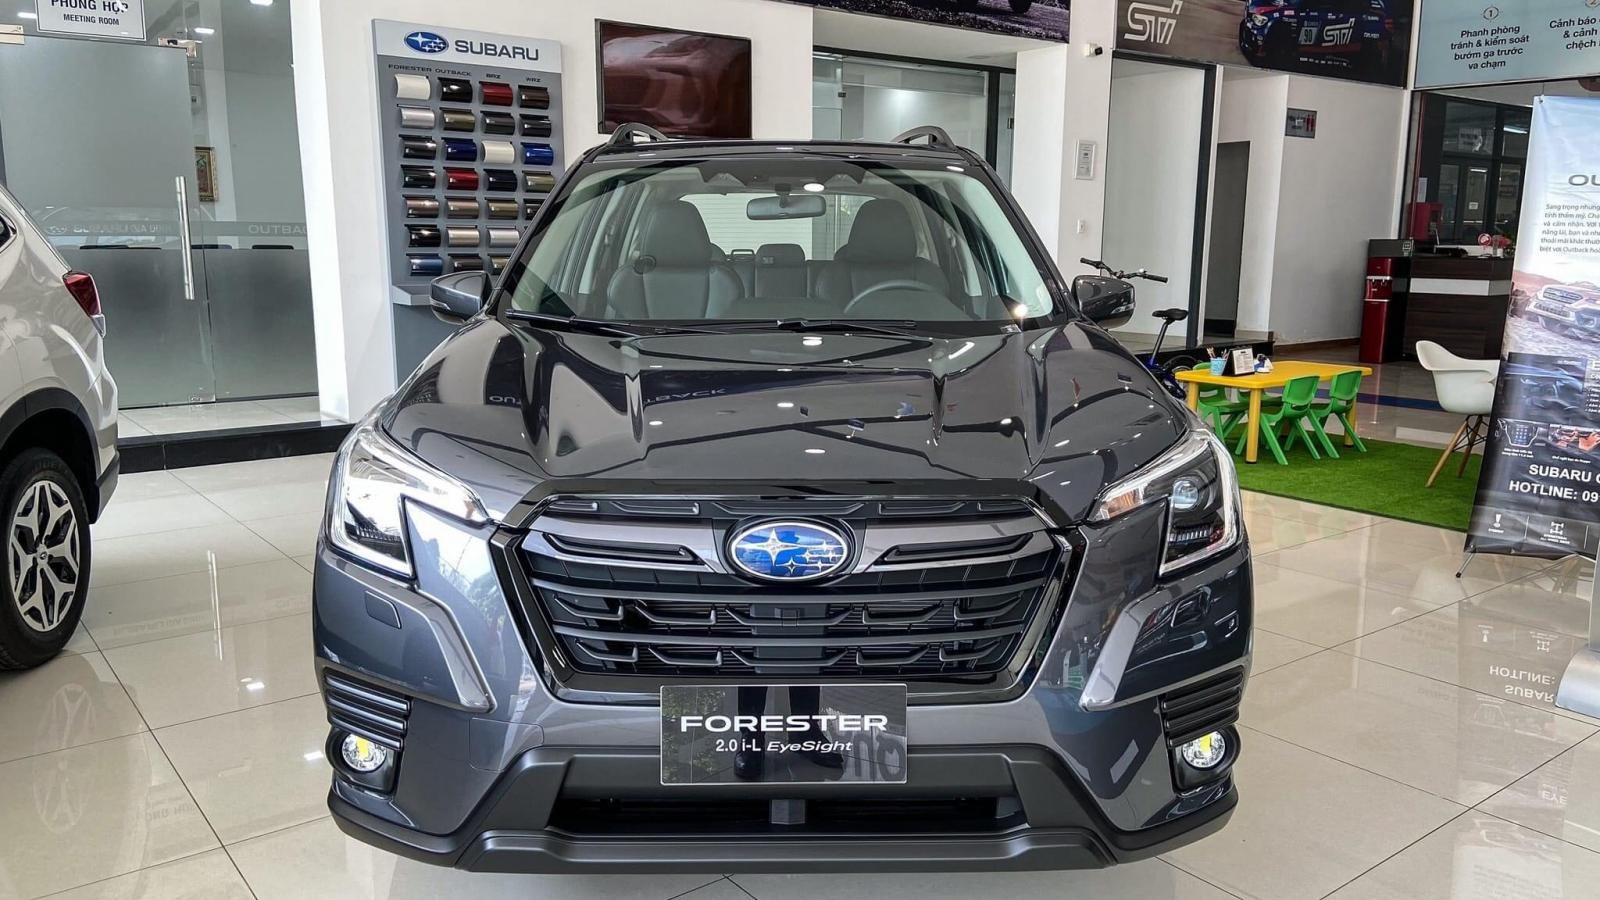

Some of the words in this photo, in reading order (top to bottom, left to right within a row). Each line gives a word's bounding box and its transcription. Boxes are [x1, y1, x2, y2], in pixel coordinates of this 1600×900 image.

[63, 14, 96, 23] MEETING
[98, 17, 120, 25] ROOM
[1549, 18, 1575, 28] Cảnh
[1577, 16, 1597, 26] báo
[1303, 29, 1314, 44] 90
[1460, 28, 1489, 38] Phanh
[1491, 26, 1520, 36] phòng
[1563, 30, 1570, 38] &
[1573, 28, 1598, 37] cảnh
[1451, 40, 1473, 50] tránh
[1485, 36, 1507, 46] kiểm
[1509, 35, 1529, 44] soát
[454, 39, 539, 61] SUBARU
[1483, 51, 1495, 59] ga
[1497, 47, 1523, 56] trước
[388, 64, 432, 72] FORESTER
[1480, 60, 1506, 69] chạm
[434, 68, 472, 76] OUTBACK
[1528, 464, 1592, 482] SUBARU
[1509, 480, 1578, 499] HOTLINE:
[680, 714, 888, 732] FORESTER
[716, 739, 738, 752] 2.0
[742, 739, 761, 752] i-L
[766, 741, 854, 753] EyeSight
